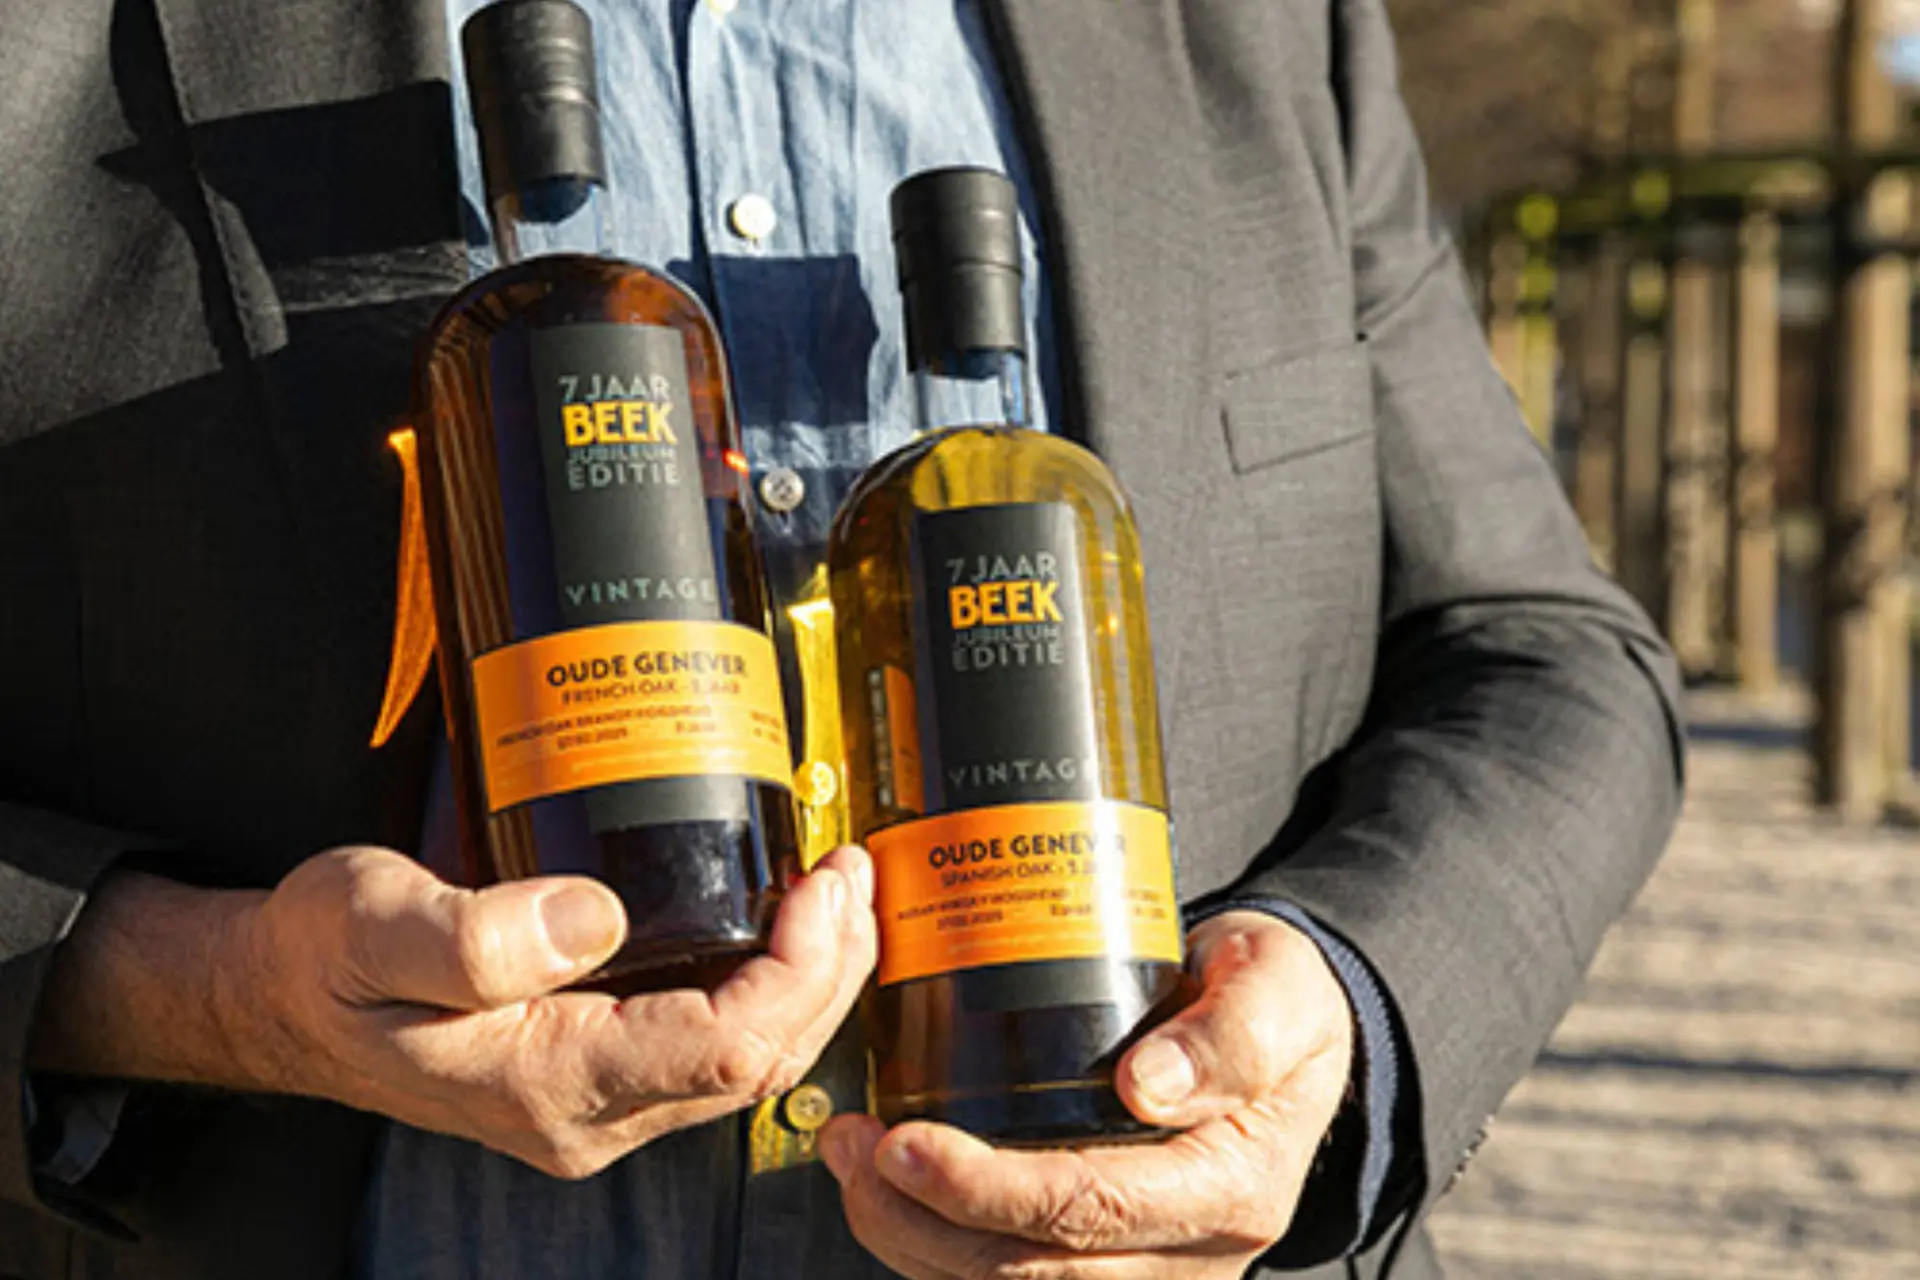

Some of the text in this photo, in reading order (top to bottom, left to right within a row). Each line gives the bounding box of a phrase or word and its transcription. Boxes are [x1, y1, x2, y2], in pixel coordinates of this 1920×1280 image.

[559, 373, 670, 402] 7 JAAR
[562, 400, 678, 447] BEEK
[568, 462, 680, 491] EDITIE
[946, 551, 1057, 583] 7 JAAR
[949, 580, 1064, 630] BEEK
[546, 651, 748, 687] OUDE GENEVER
[952, 643, 1065, 672] EDITIE
[948, 757, 1092, 789] VINTAG
[928, 833, 1127, 871] OUDE GENEVR
